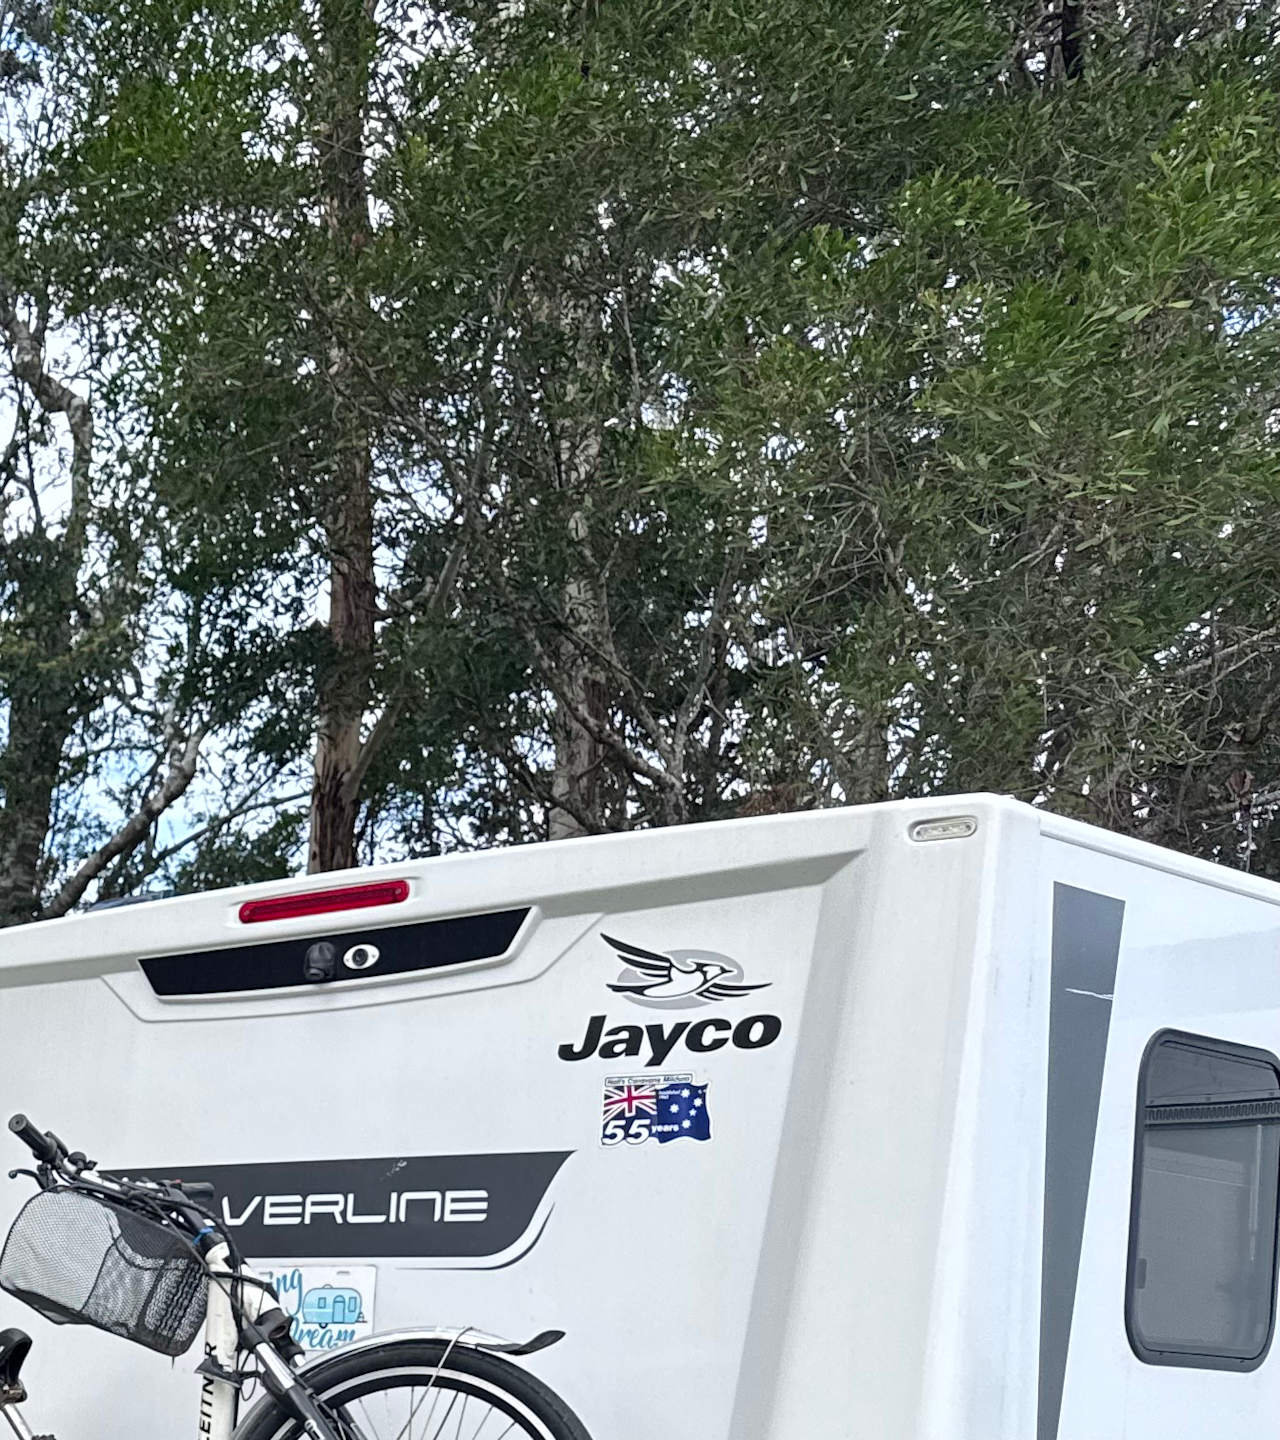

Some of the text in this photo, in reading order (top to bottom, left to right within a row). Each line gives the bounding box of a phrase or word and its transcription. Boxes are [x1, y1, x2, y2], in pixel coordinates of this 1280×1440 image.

[557, 1014, 782, 1067] Jayco
[601, 1119, 679, 1145] 55 years
[206, 1189, 489, 1226] VERLINE
